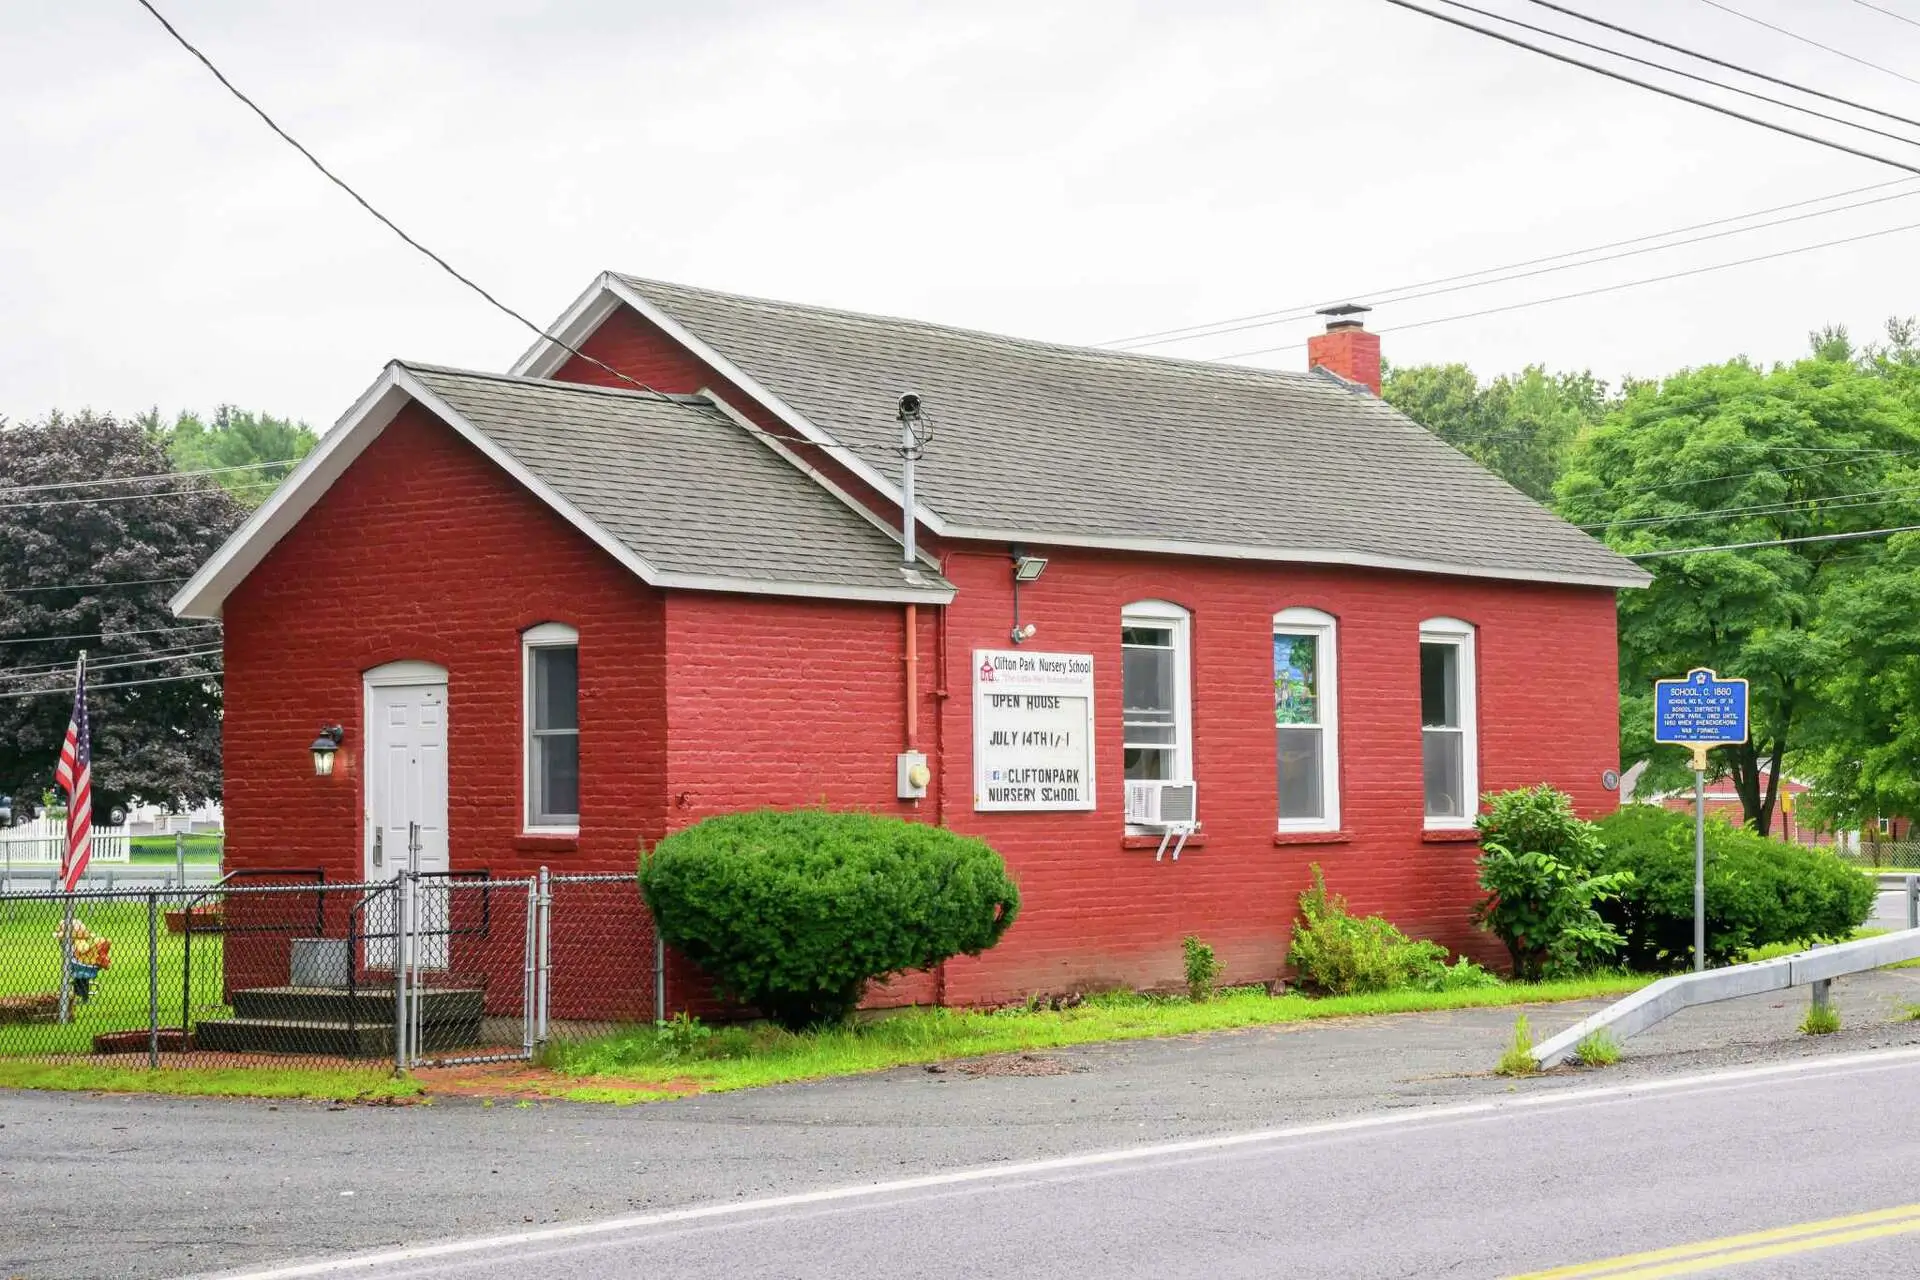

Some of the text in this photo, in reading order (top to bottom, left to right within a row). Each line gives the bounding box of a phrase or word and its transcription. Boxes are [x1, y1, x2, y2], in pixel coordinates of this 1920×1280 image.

[993, 655, 1091, 675] Clifton Park Nursery School
[992, 694, 1061, 710] OPEN HOUSE
[989, 730, 1018, 746] JULY
[1022, 731, 1047, 747] 14TH
[988, 787, 1080, 802] NURSERY SCHOOL
